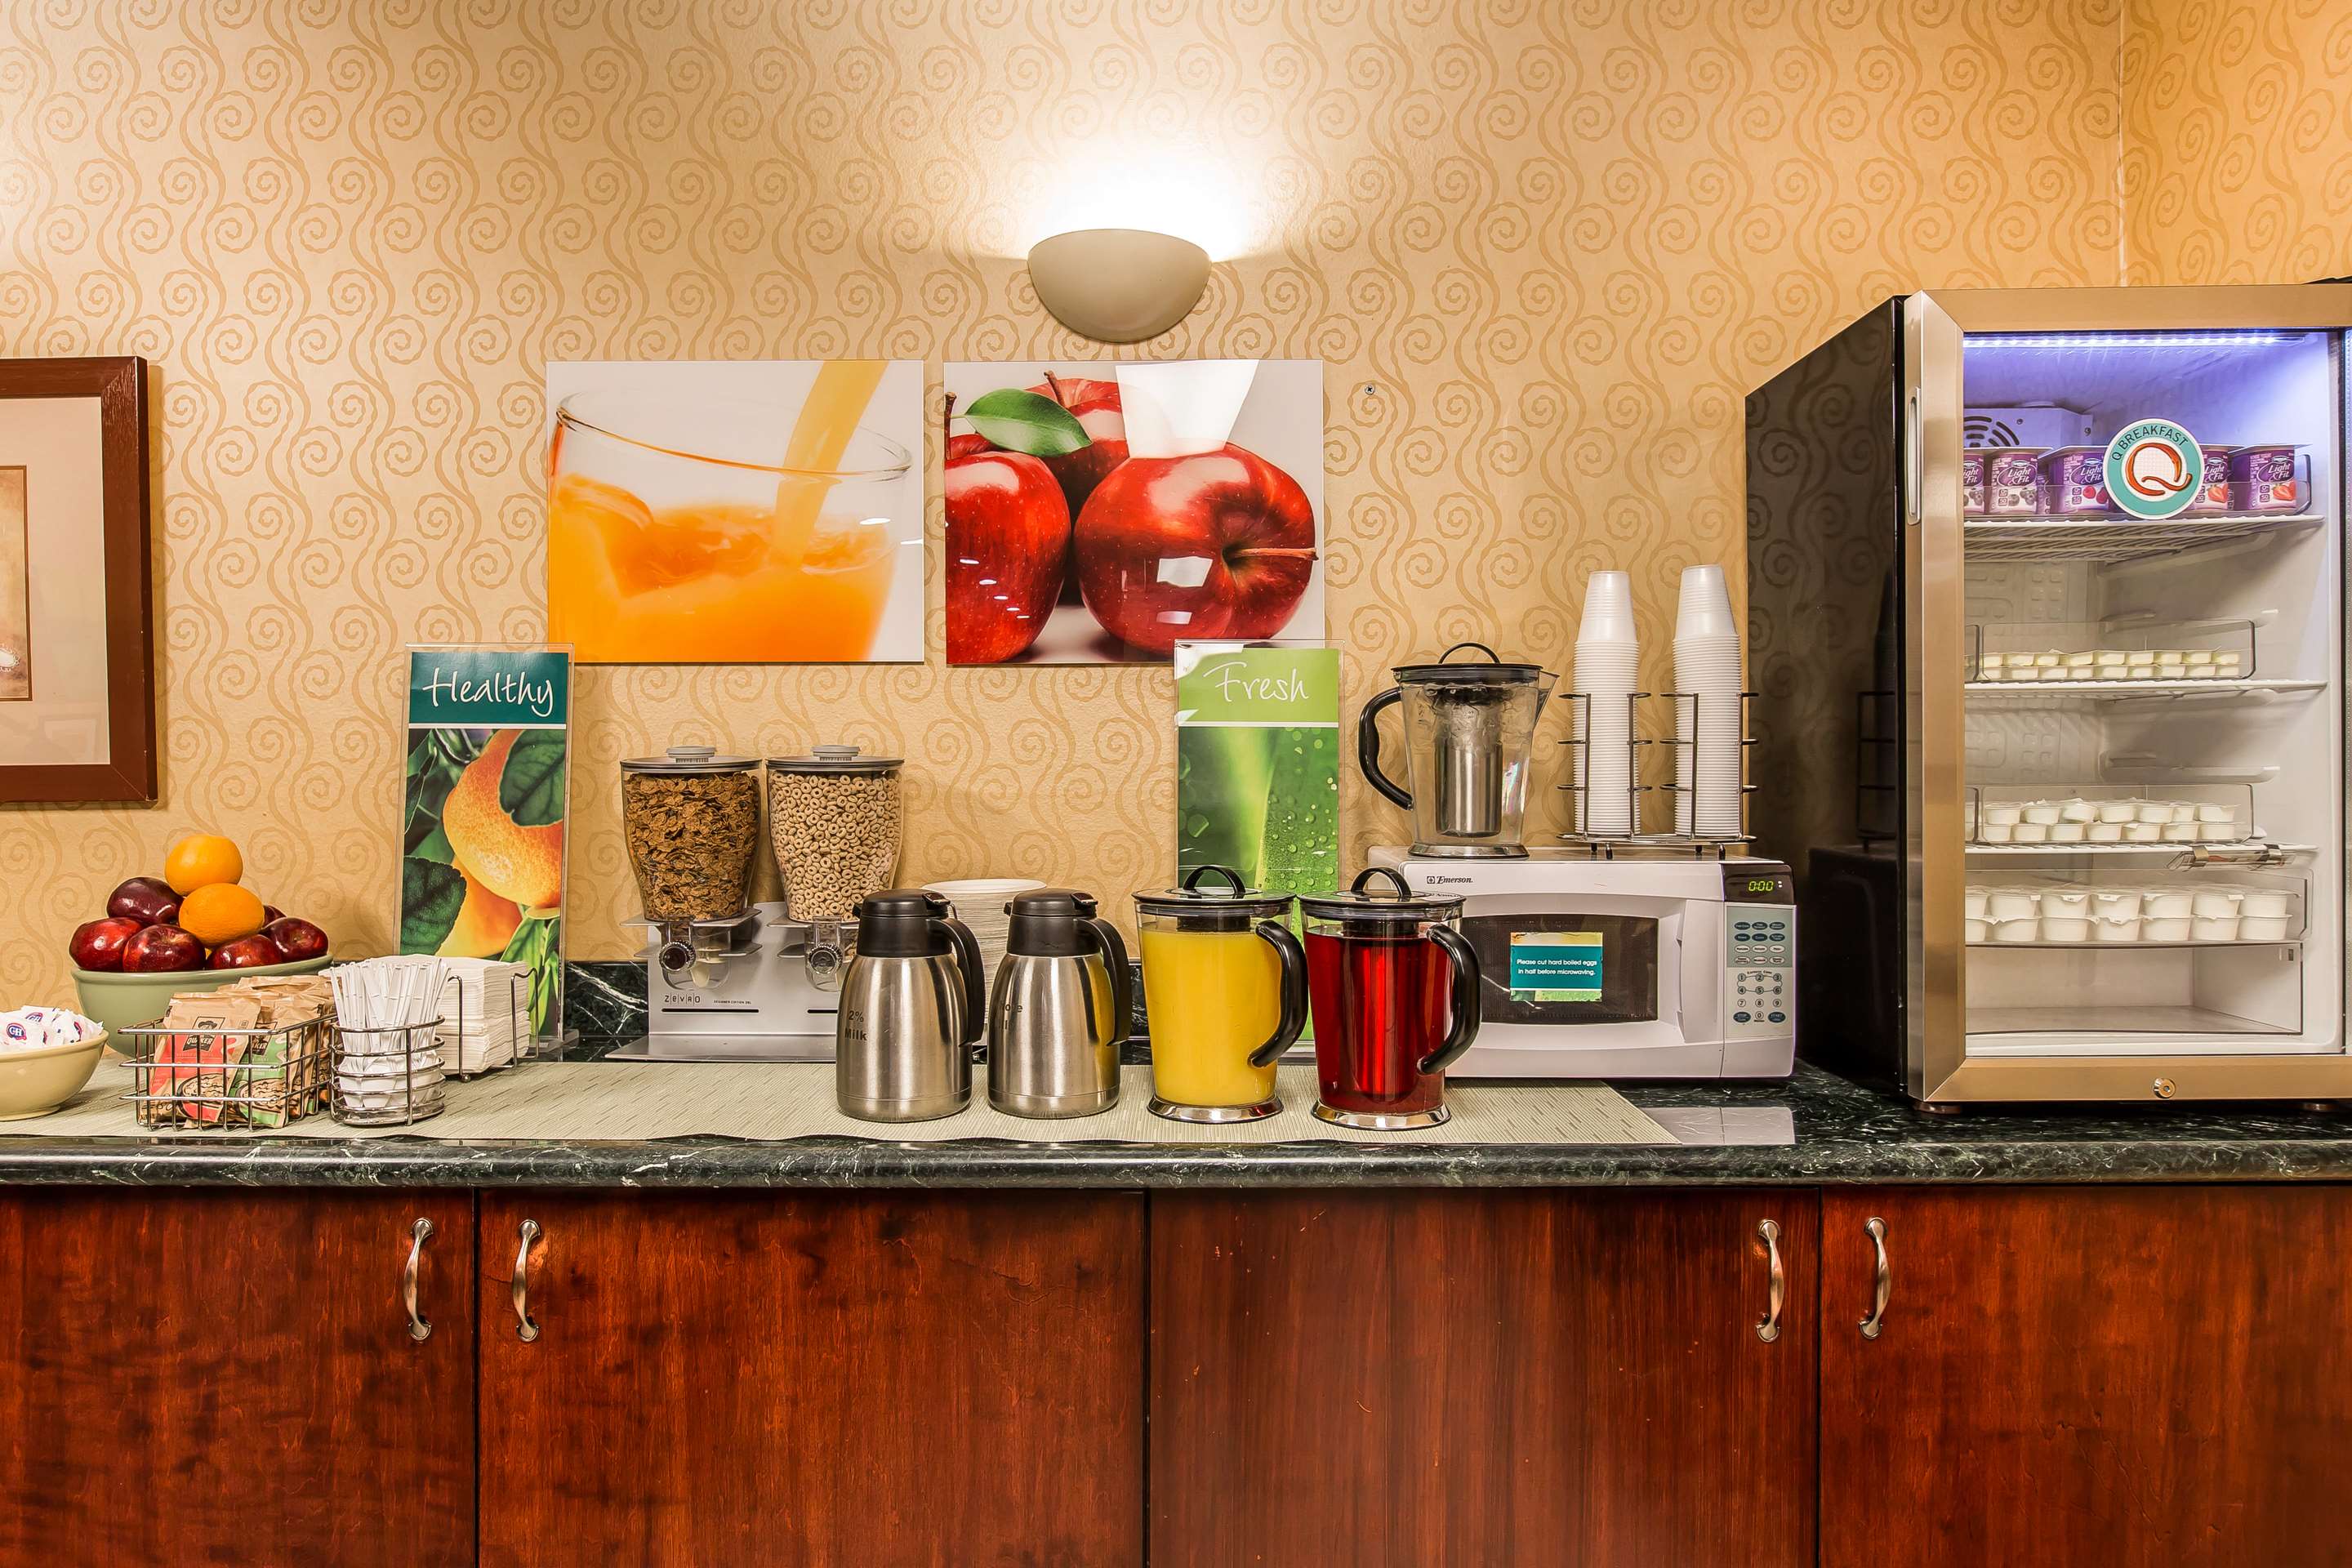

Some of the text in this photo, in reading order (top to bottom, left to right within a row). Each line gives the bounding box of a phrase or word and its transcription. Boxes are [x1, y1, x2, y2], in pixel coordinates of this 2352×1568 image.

[2112, 425, 2189, 461] Q BREAKFAST
[2007, 466, 2031, 479] Light
[2125, 442, 2193, 497] Q
[2268, 462, 2291, 474] Light
[1202, 661, 1309, 702] Fresh
[421, 666, 554, 718] Healthy
[1437, 875, 1473, 884] Emerson
[1748, 880, 1774, 892] 0:00
[849, 1009, 864, 1022] 2%
[186, 1036, 213, 1045] QUKER
[844, 1027, 867, 1041] Milk
